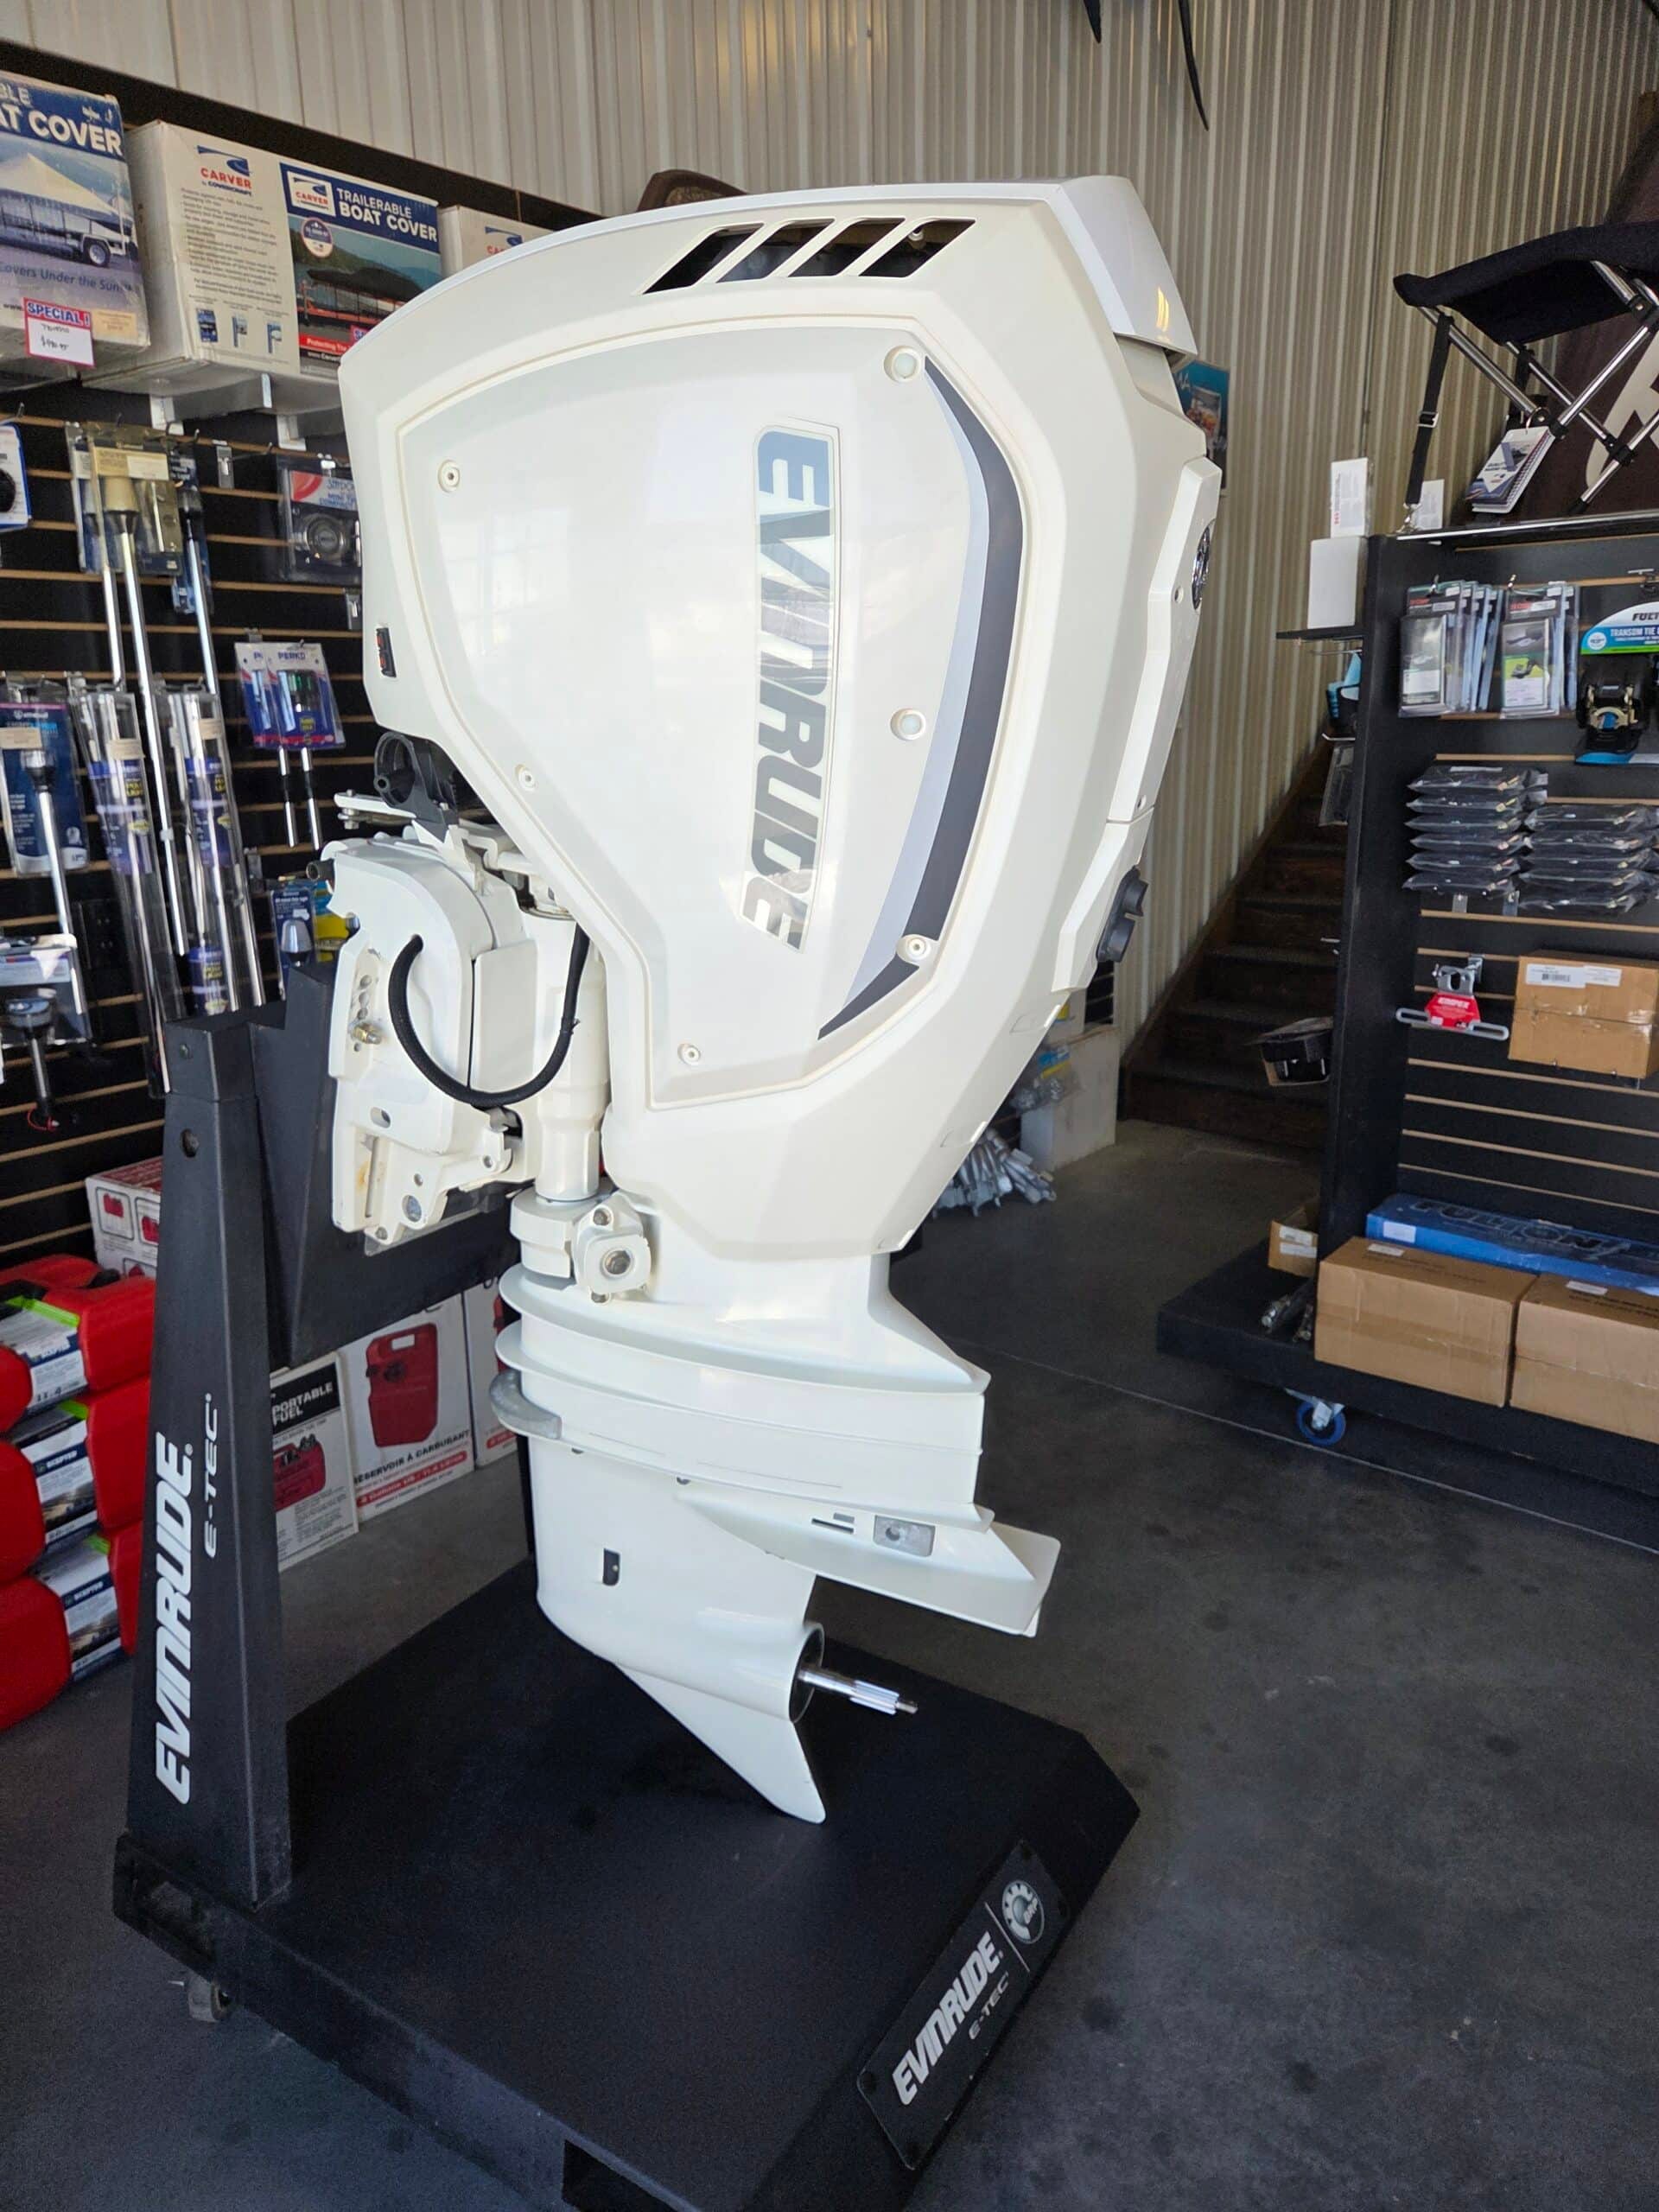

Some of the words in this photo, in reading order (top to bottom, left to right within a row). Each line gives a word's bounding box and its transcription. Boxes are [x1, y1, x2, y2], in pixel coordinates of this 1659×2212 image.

[29, 110, 123, 156] COVER
[200, 168, 251, 189] CARVER
[336, 188, 412, 219] TRAILERABLE
[339, 201, 382, 226] BOAT
[386, 215, 438, 243] COVER
[40, 269, 75, 284] Under
[79, 275, 97, 289] the
[28, 302, 81, 325] SPECIAL
[741, 429, 835, 953] EVINRUDE
[272, 1382, 333, 1414] PORTABLE
[272, 1406, 303, 1427] FUEL
[416, 1430, 470, 1457] CARBURANT
[205, 1398, 217, 1558] E-TEC
[156, 1432, 193, 1804] EVINRUDE
[892, 1931, 1001, 2106] EVINRUDE
[969, 1971, 1009, 2040] E-TEC
